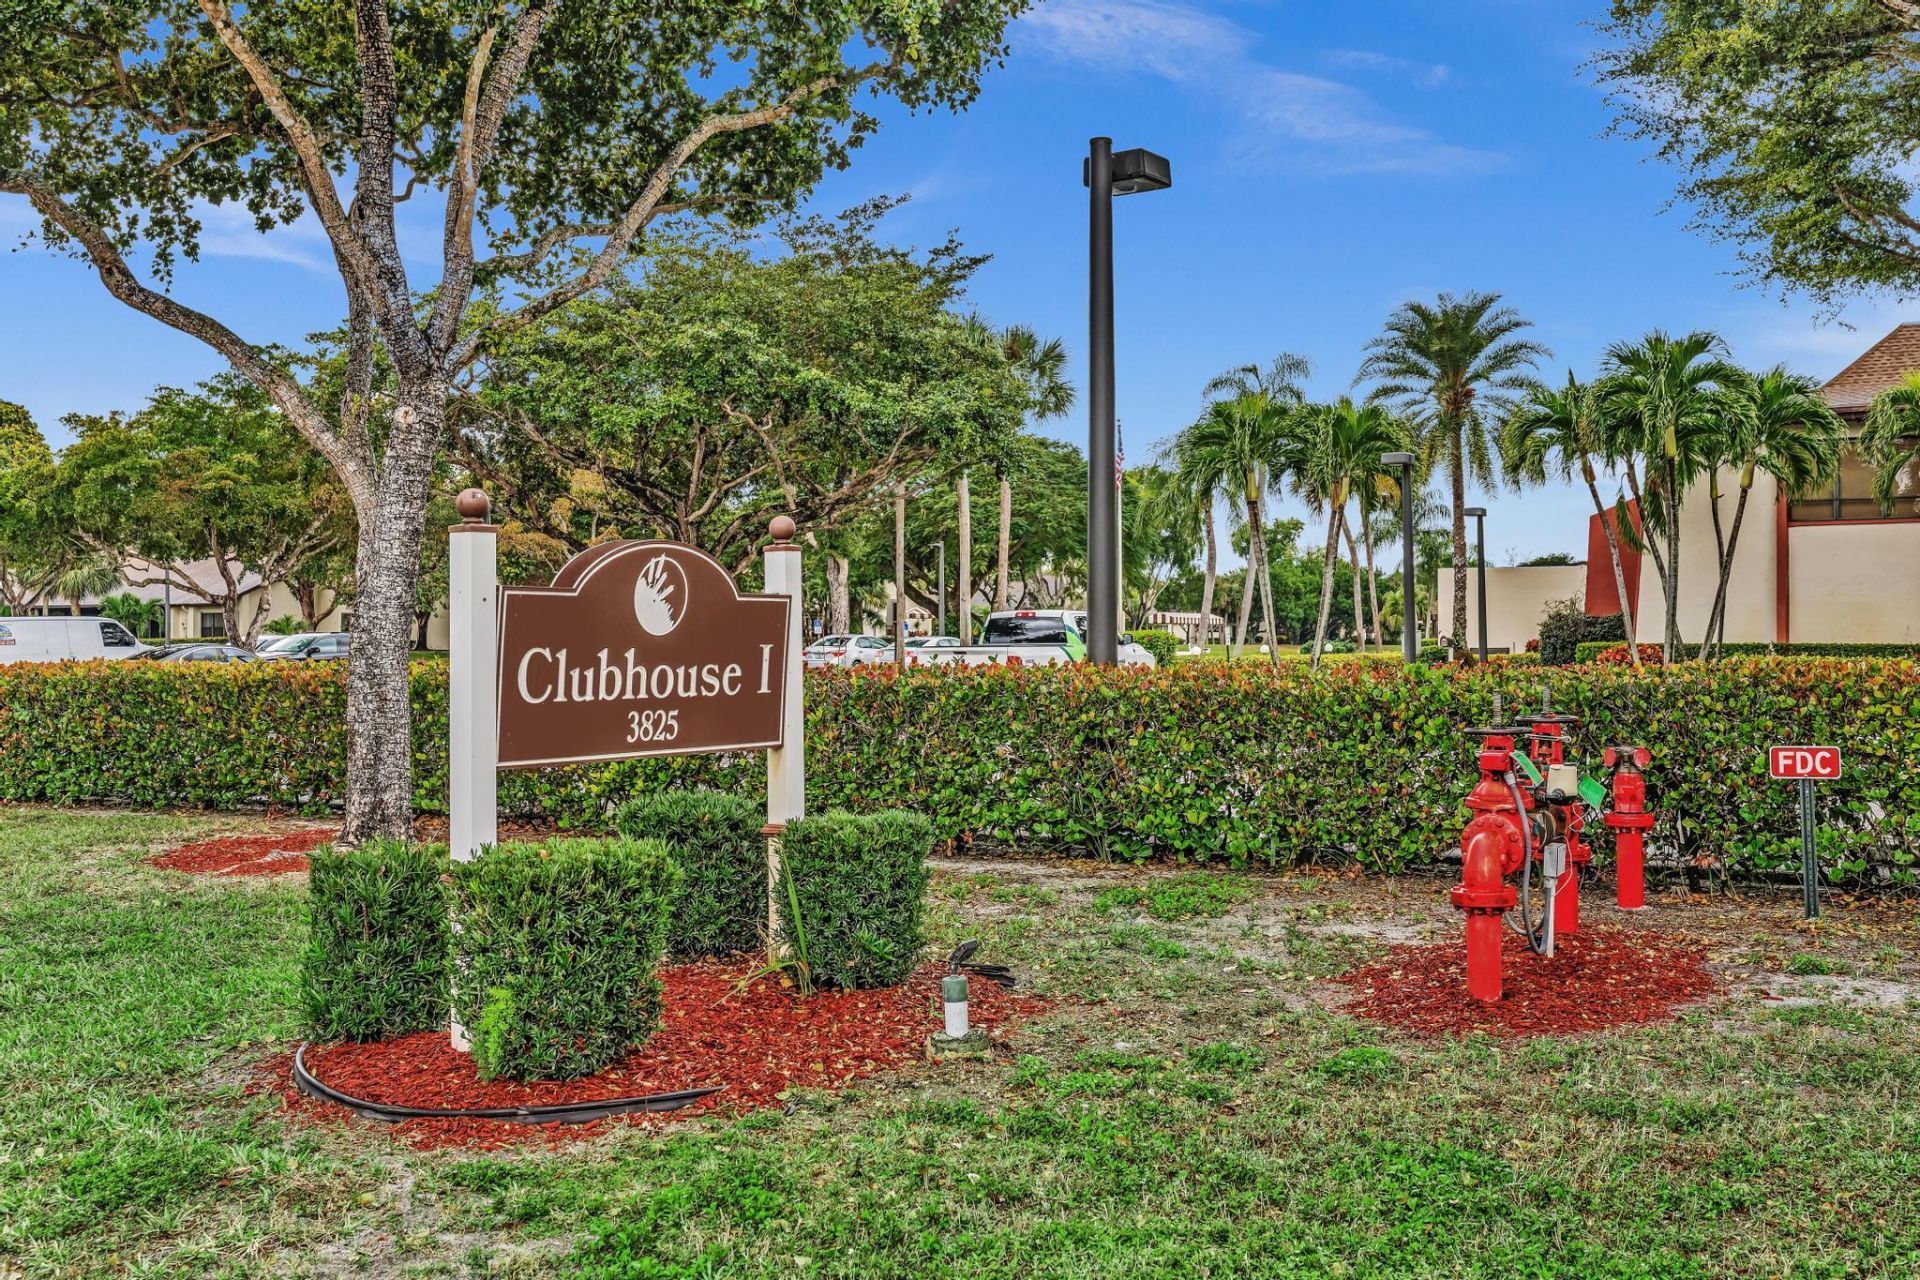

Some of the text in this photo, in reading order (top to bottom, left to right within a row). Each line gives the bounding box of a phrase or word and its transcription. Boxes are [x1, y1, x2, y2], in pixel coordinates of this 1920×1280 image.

[517, 643, 774, 704] Clubhouse I
[626, 709, 679, 743] 3825
[1778, 751, 1832, 774] FDC
